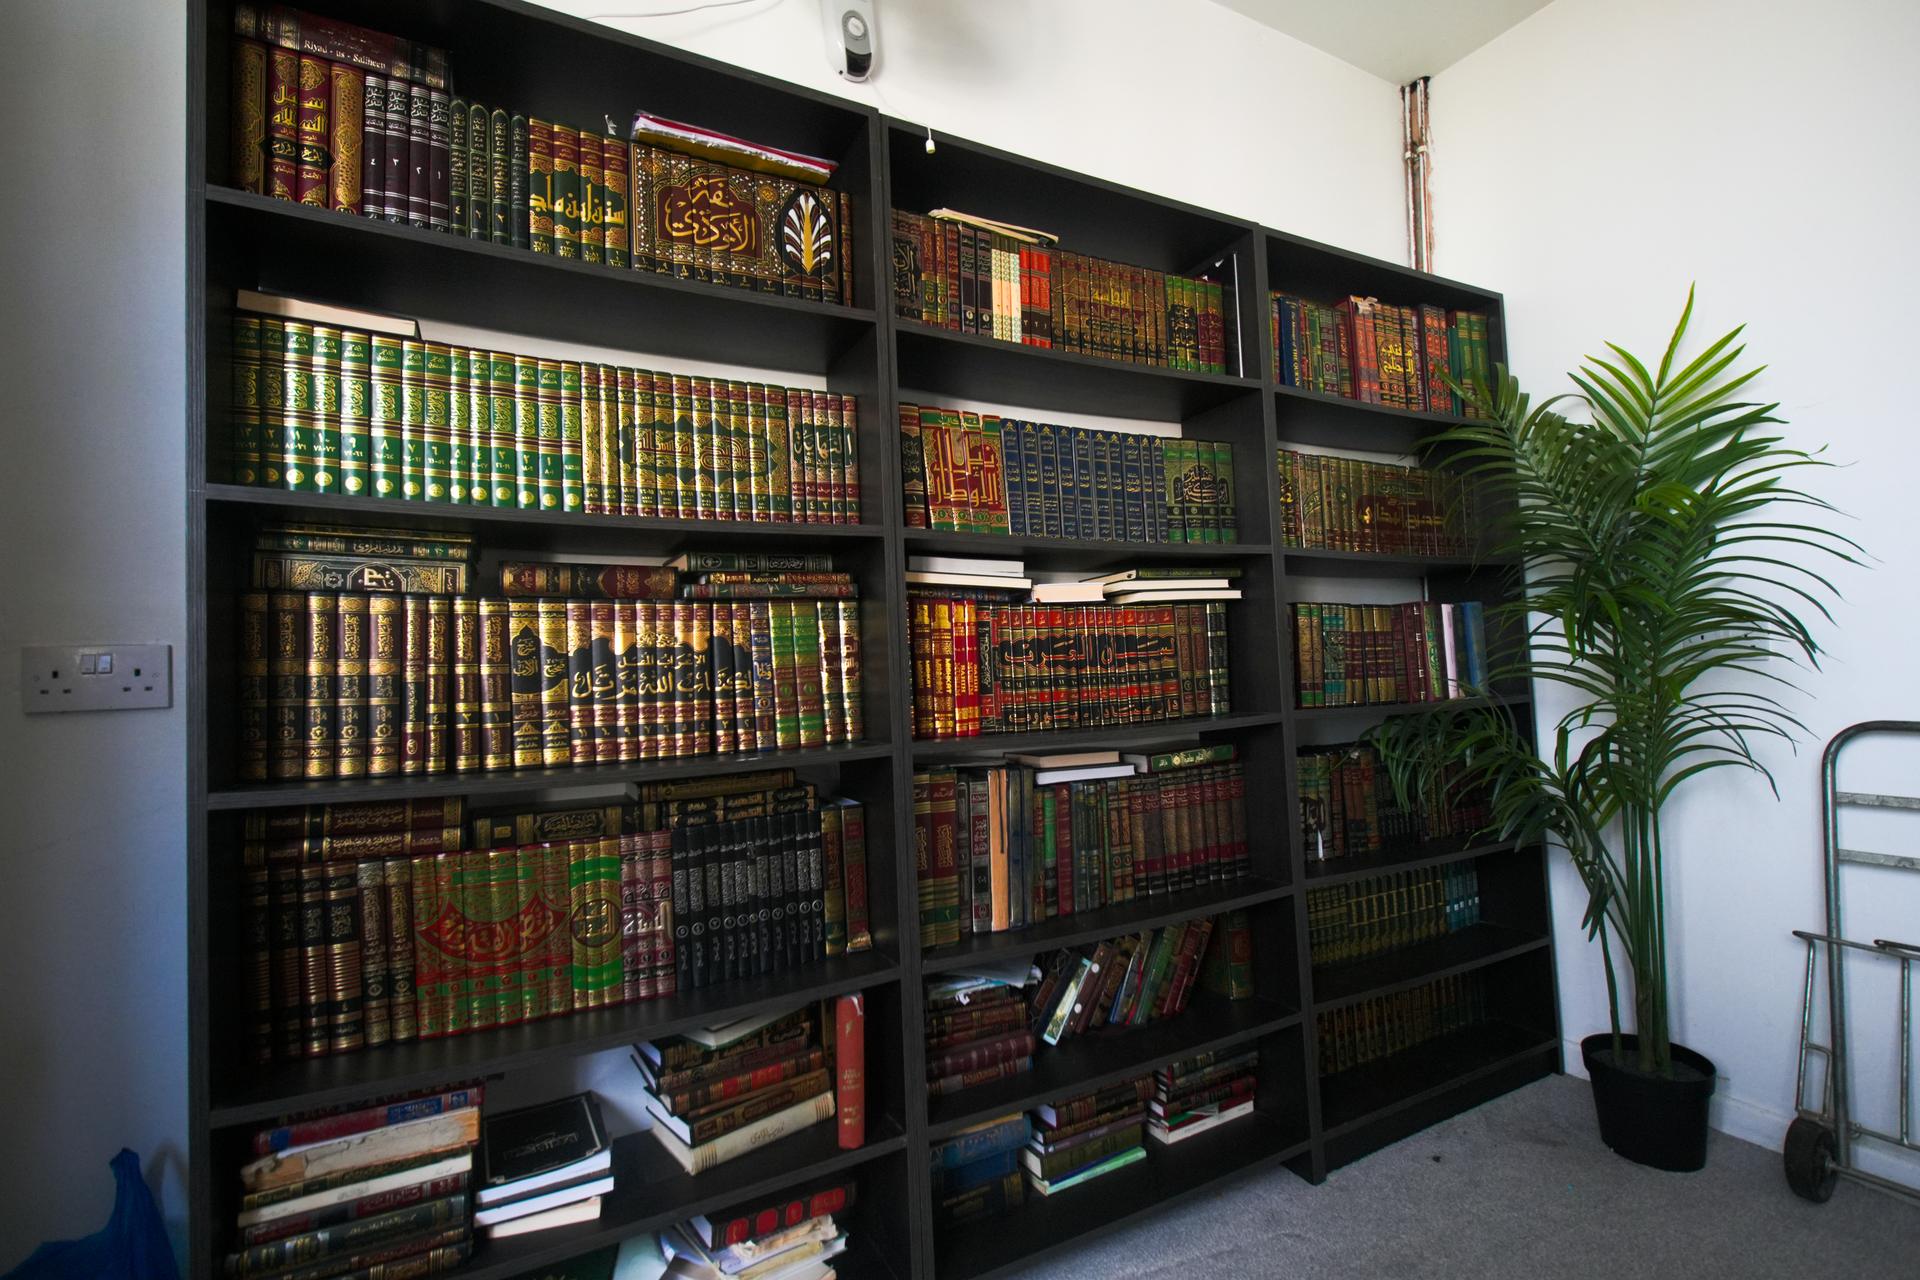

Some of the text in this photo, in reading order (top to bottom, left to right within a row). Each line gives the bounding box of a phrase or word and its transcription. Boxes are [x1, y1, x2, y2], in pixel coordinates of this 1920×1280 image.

[303, 40, 328, 54] Riyad
[335, 49, 346, 58] us
[353, 53, 386, 69] Saliheen
[945, 658, 953, 694] MISHKAT
